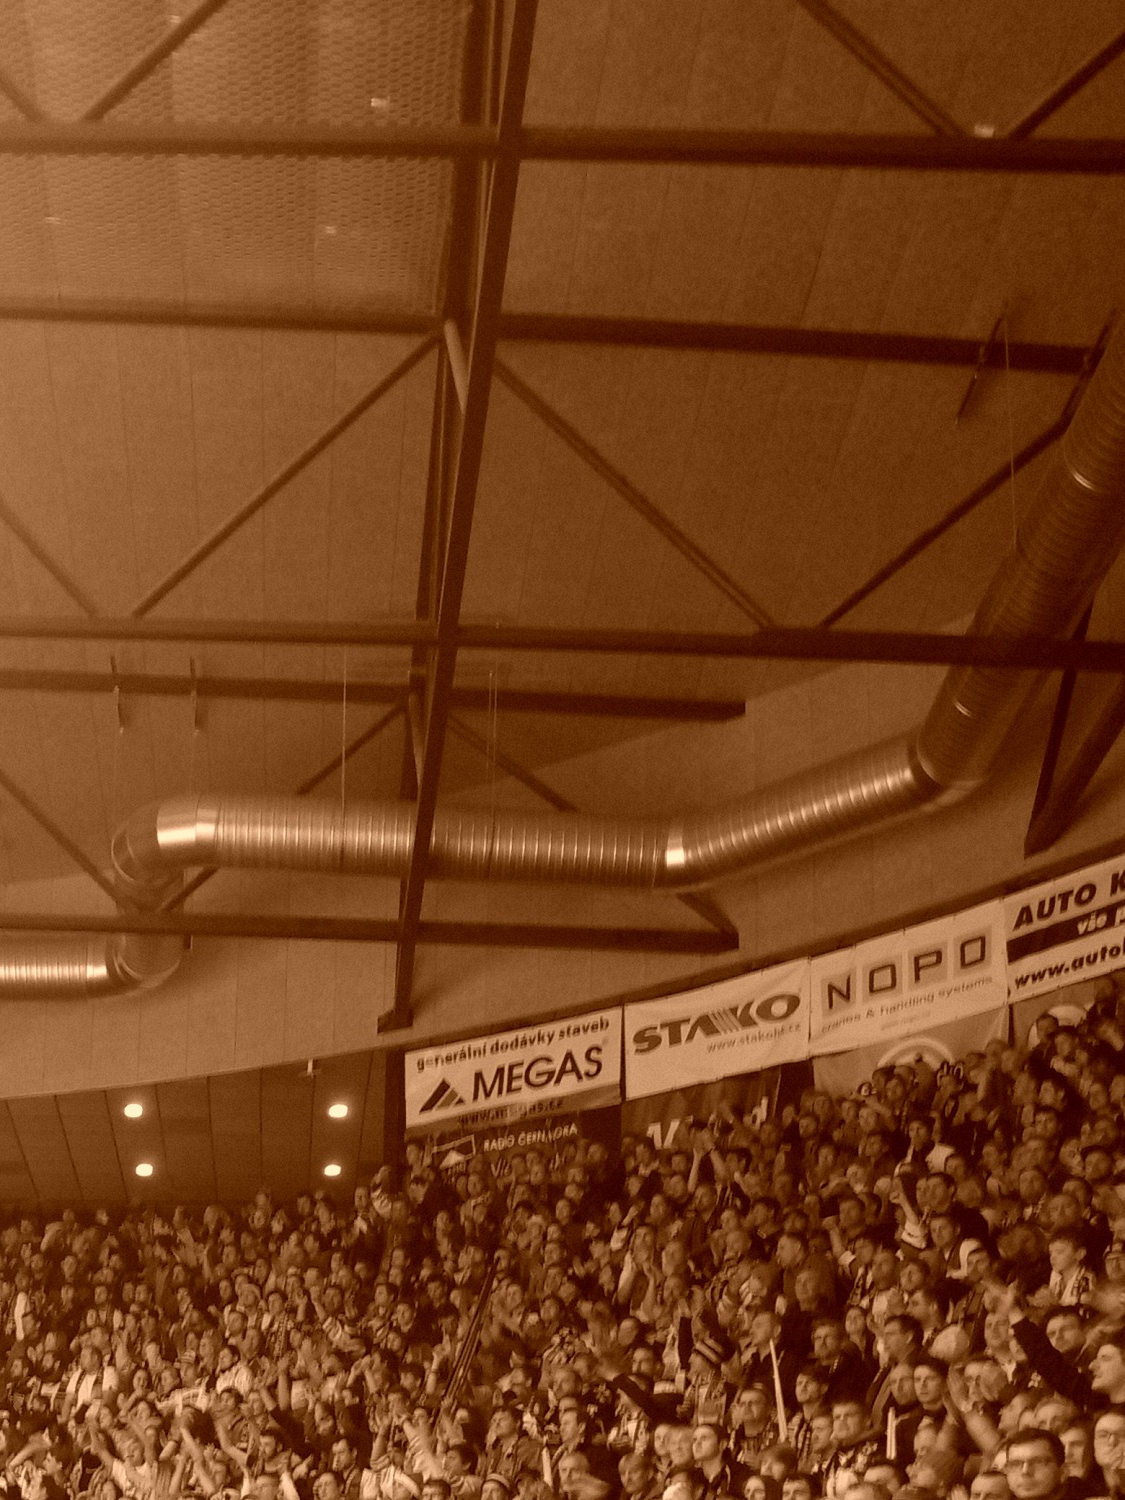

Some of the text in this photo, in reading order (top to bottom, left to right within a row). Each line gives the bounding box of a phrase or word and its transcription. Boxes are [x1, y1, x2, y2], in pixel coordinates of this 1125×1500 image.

[1013, 883, 1096, 931] AUTO
[827, 935, 987, 1011] NOPO
[1015, 937, 1125, 989] www.auto
[632, 993, 801, 1055] STAKO
[880, 992, 935, 1017] handling
[938, 976, 993, 999] systems
[416, 1016, 610, 1074] generální dodávky staveb
[472, 1045, 604, 1102] MEGAS
